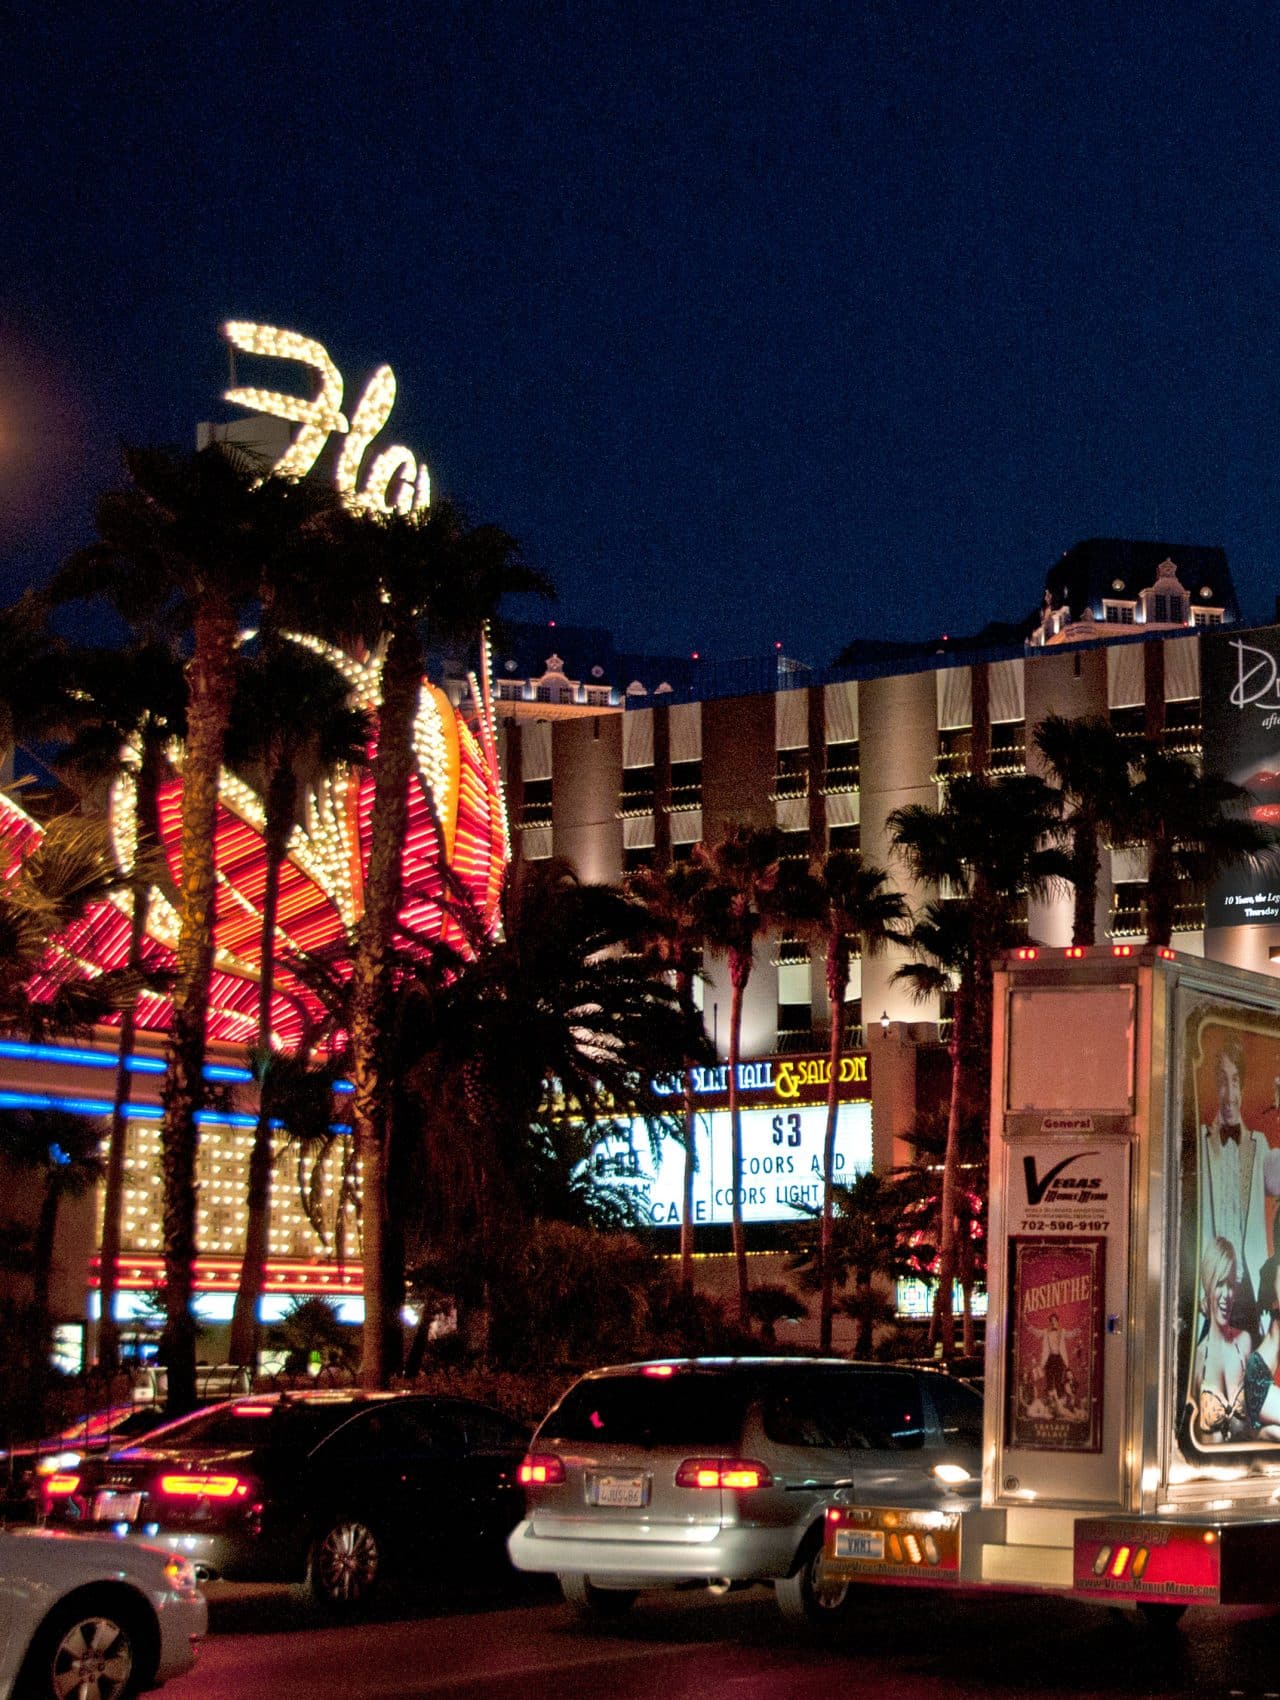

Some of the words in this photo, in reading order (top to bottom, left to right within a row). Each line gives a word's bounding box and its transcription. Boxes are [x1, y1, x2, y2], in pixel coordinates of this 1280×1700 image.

[1244, 905, 1279, 918] Thursday
[775, 1062, 800, 1098] &
[773, 1113, 801, 1147] $3
[1043, 1119, 1091, 1129] General
[811, 1152, 845, 1172] AD
[776, 1184, 819, 1204] LIGHT
[650, 1201, 708, 1223] CAE
[1021, 1221, 1110, 1231] 702-596-9197
[1023, 1275, 1091, 1313] ABSINTHE
